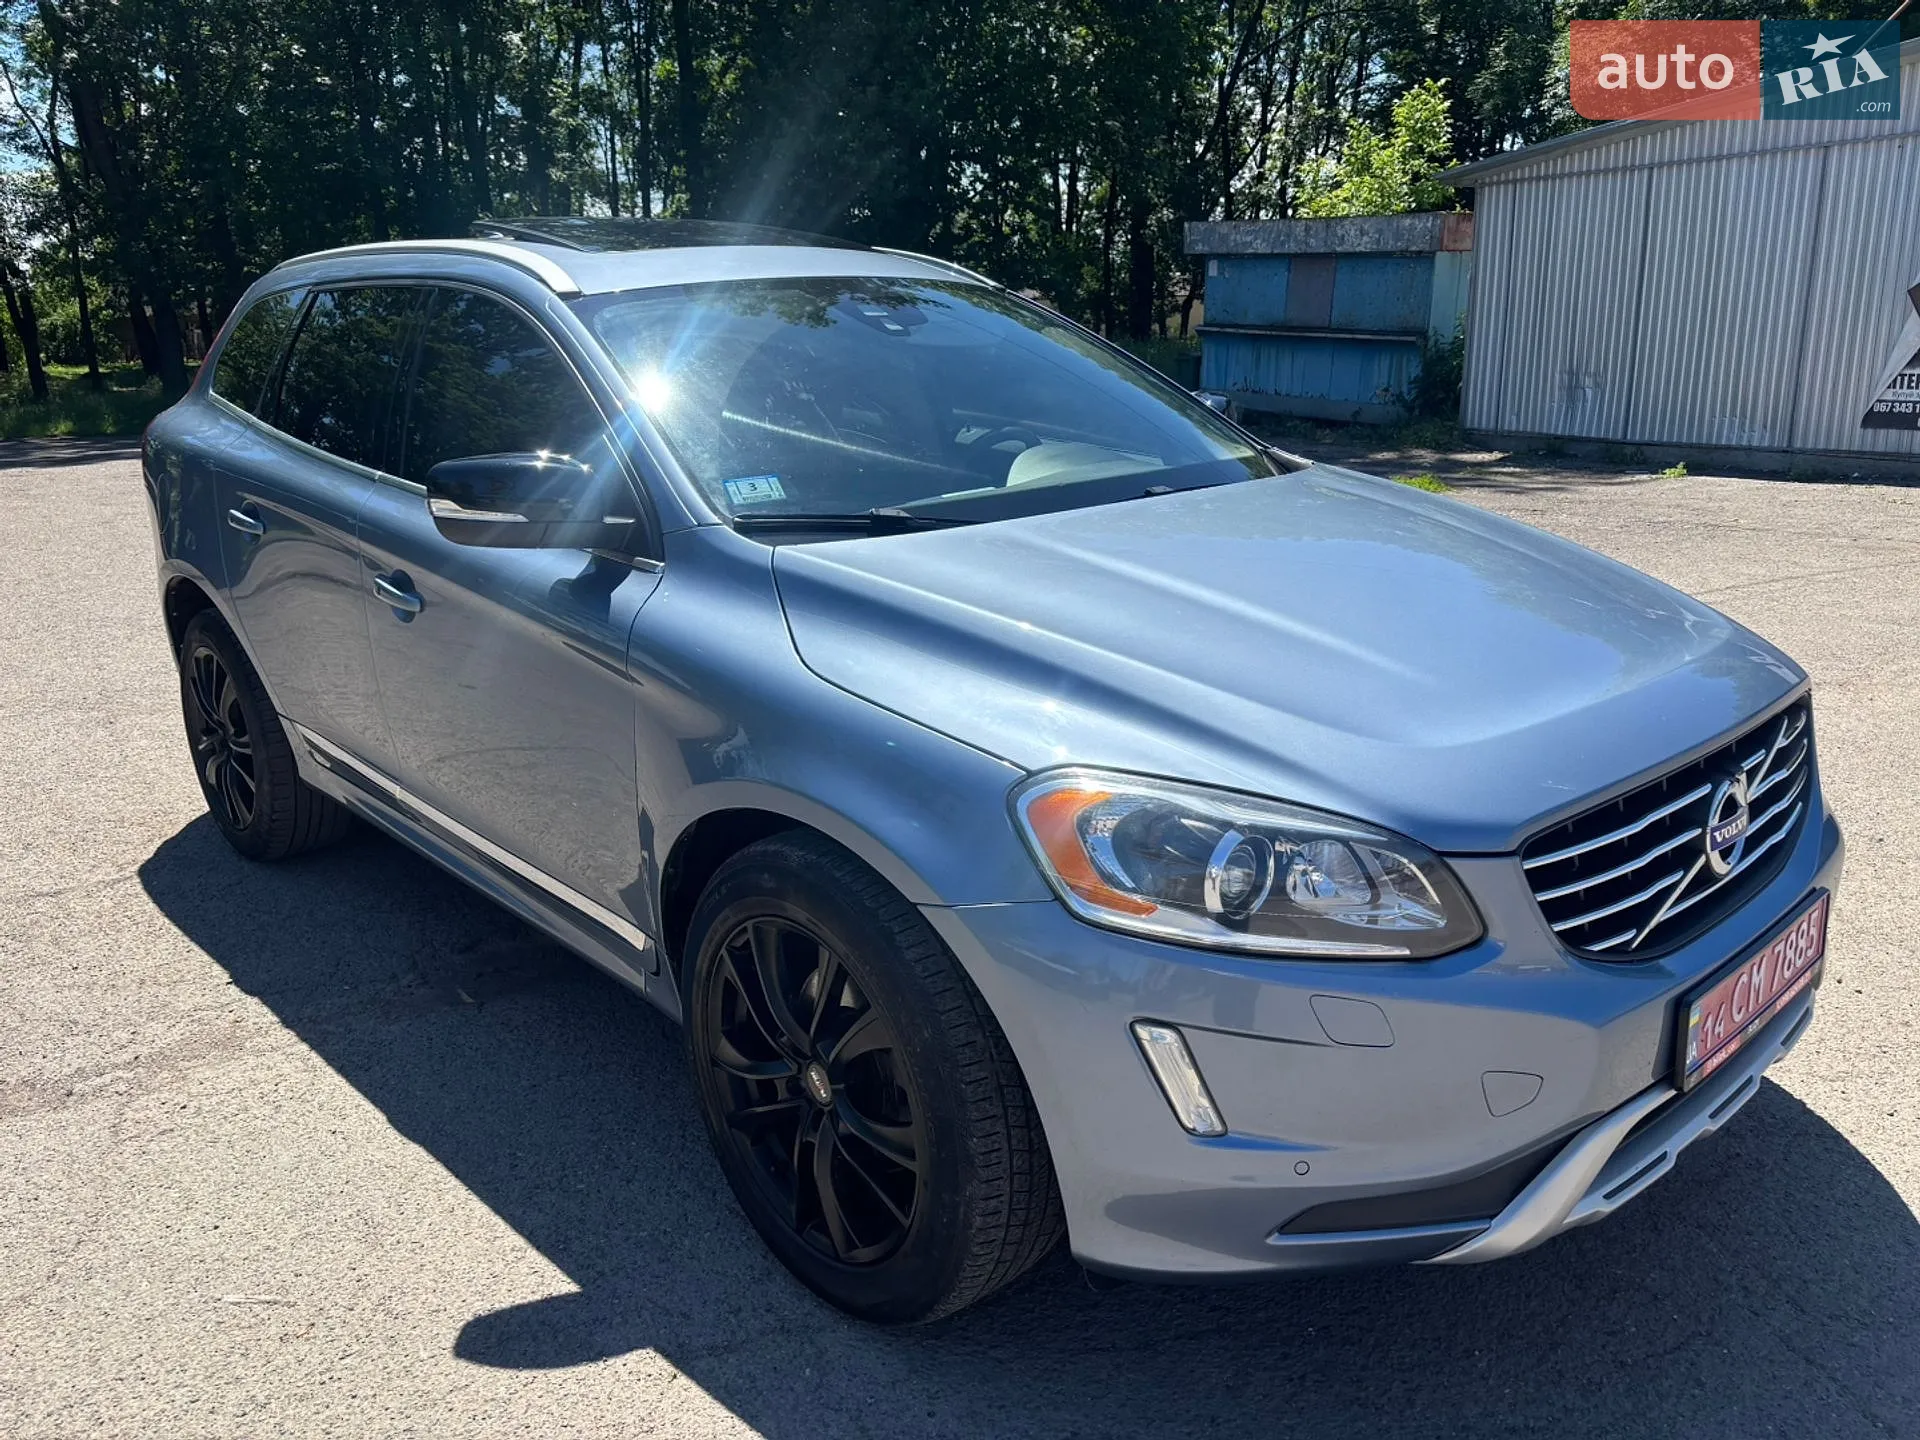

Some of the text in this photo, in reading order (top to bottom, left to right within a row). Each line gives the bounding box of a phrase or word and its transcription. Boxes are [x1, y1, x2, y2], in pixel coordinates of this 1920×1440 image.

[748, 482, 758, 492] 3
[1703, 1002, 1726, 1050] 14
[1732, 955, 1767, 1023] CM
[1770, 910, 1820, 993] 7885
